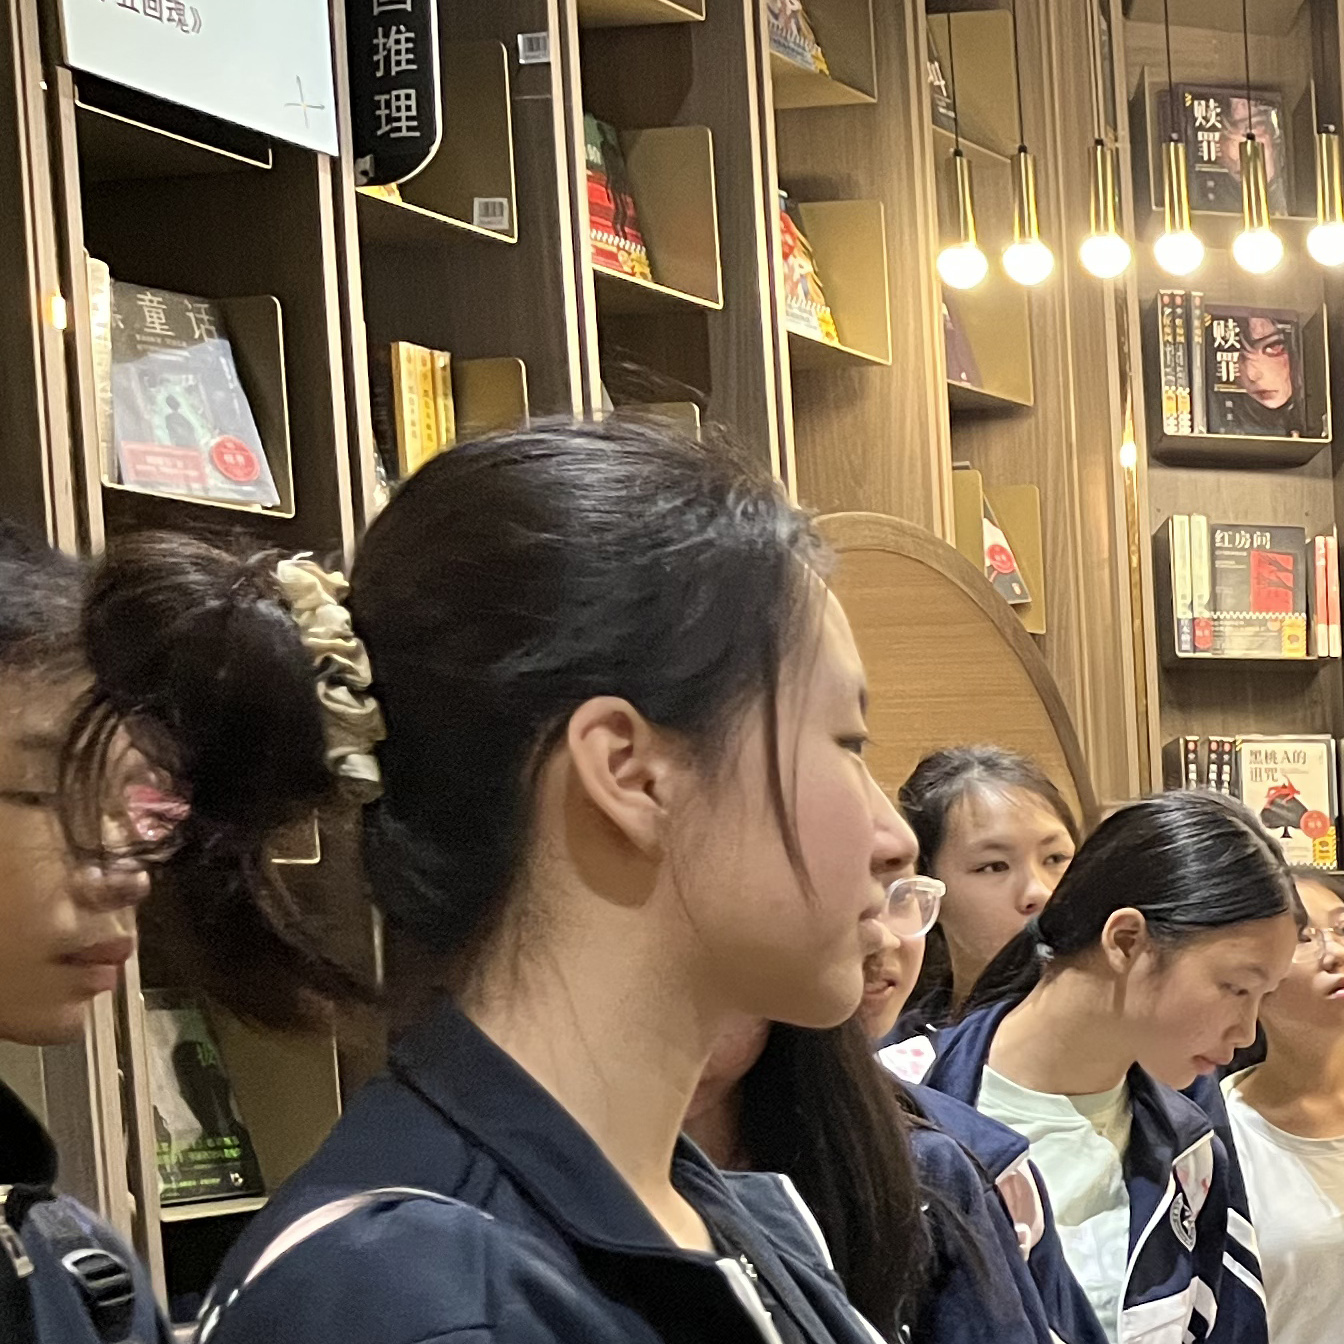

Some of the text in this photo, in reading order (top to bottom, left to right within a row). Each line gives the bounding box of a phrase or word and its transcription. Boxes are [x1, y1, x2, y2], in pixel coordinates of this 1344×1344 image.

[1193, 99, 1223, 163] 赎罪
[1212, 319, 1241, 382] 赎罪
[1215, 530, 1271, 549] 红房间
[1249, 750, 1307, 765] 黑桃A的
